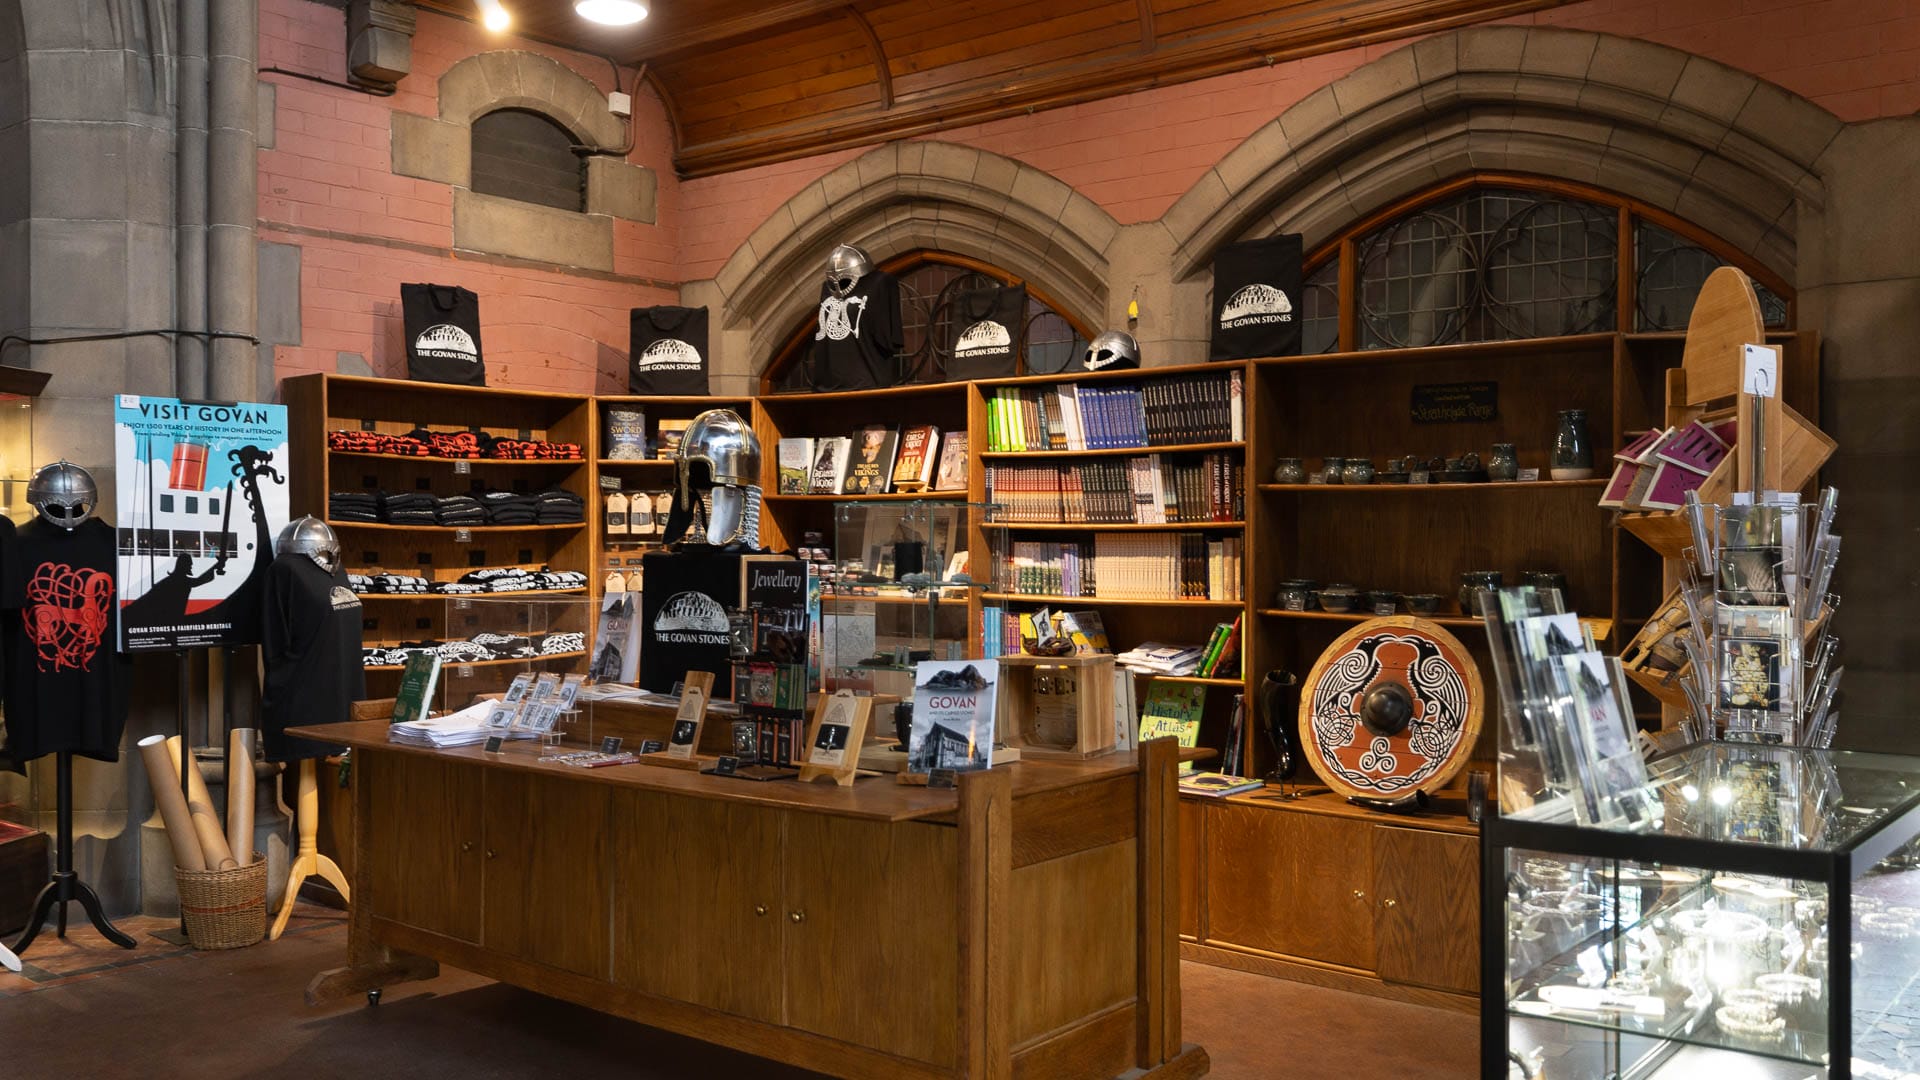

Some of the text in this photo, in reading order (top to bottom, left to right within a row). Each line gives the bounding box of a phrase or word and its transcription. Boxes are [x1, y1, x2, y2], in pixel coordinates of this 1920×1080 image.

[1220, 314, 1292, 329] THE GOVAN STONES
[457, 353, 477, 363] STONES
[966, 349, 986, 357] GOVAN
[987, 347, 1010, 355] STONES
[139, 403, 267, 424] VISIT GOVAN
[752, 569, 801, 592] Jewellery
[656, 632, 730, 645] THE GOVAN STONES
[930, 696, 976, 708] GOVAN
[1150, 704, 1193, 721] History
[1156, 720, 1185, 733] Atlas
